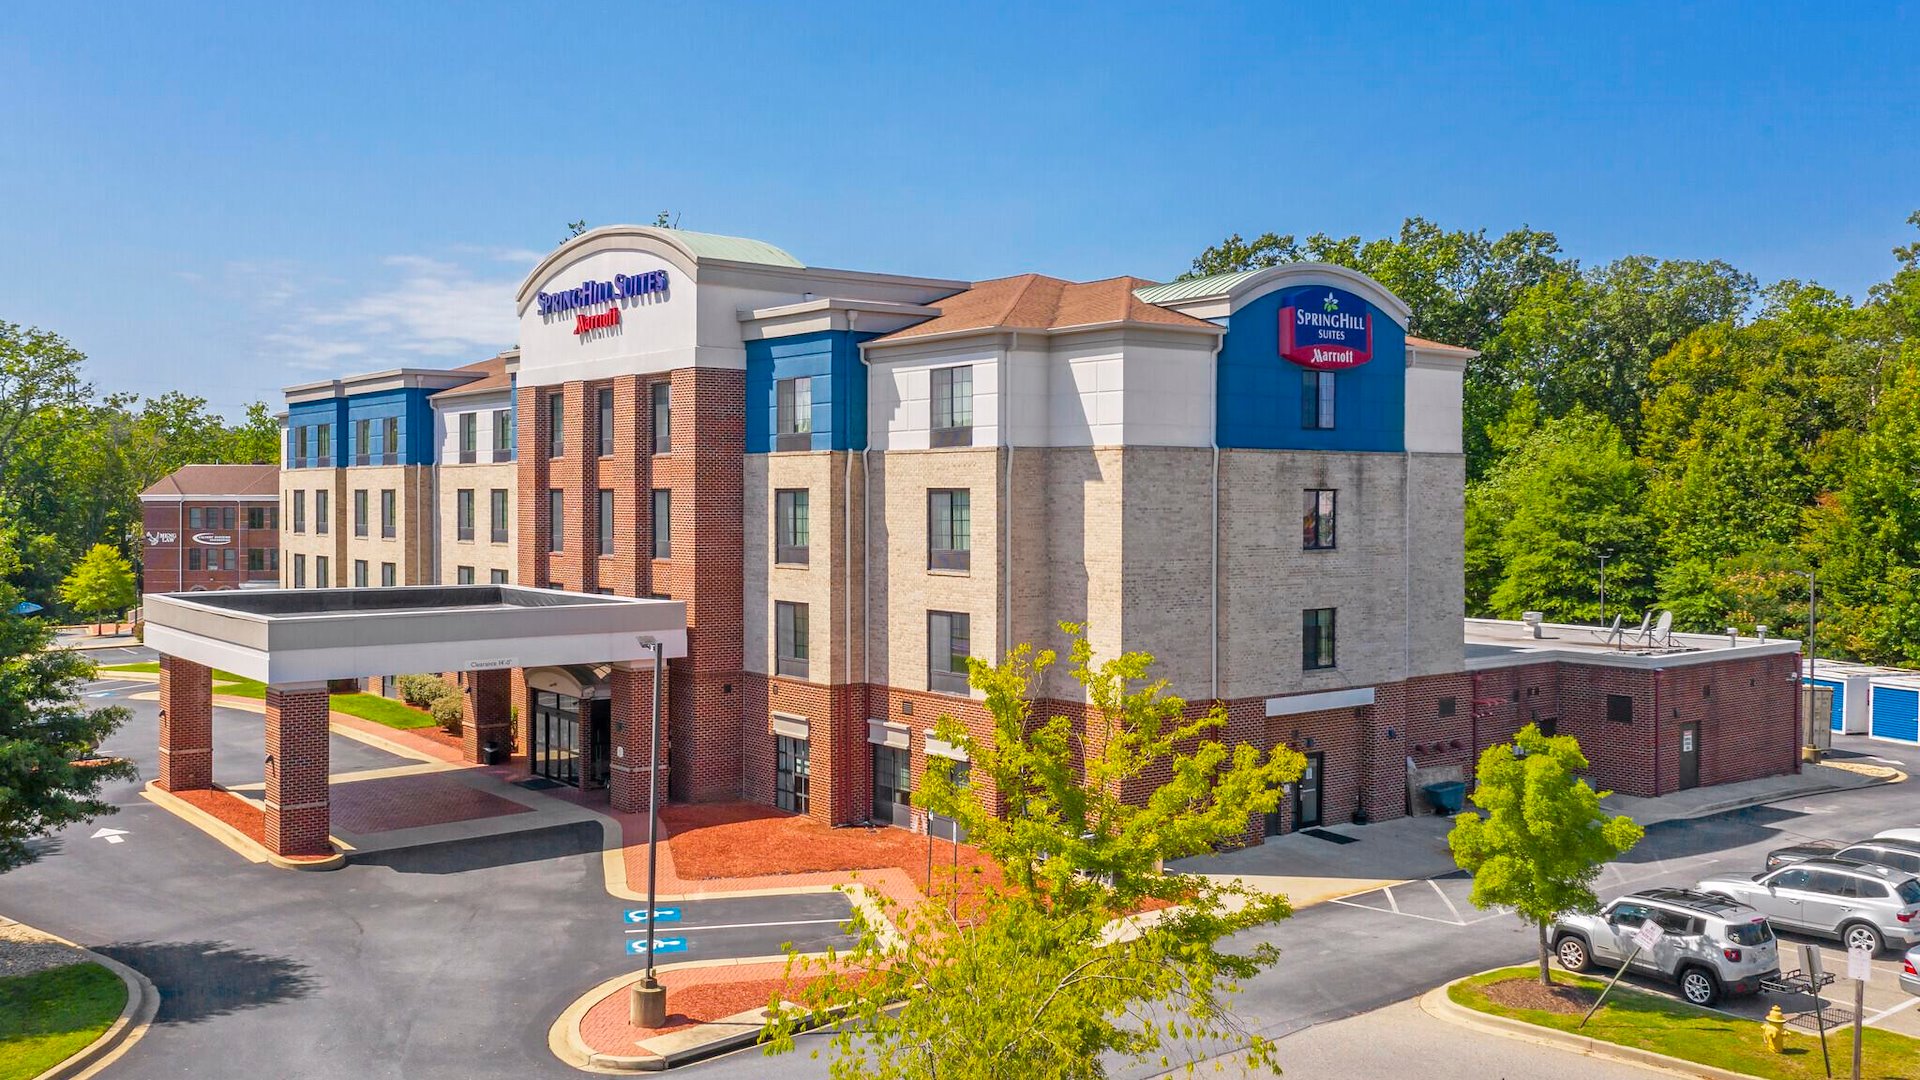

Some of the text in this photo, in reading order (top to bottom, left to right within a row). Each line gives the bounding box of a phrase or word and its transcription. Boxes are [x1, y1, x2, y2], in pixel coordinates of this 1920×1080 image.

[614, 269, 669, 300] SUITES
[573, 307, 620, 335] Marriott
[1297, 309, 1365, 330] SPRINGHILL
[1318, 329, 1345, 340] SUITES
[1311, 348, 1353, 363] Marriott
